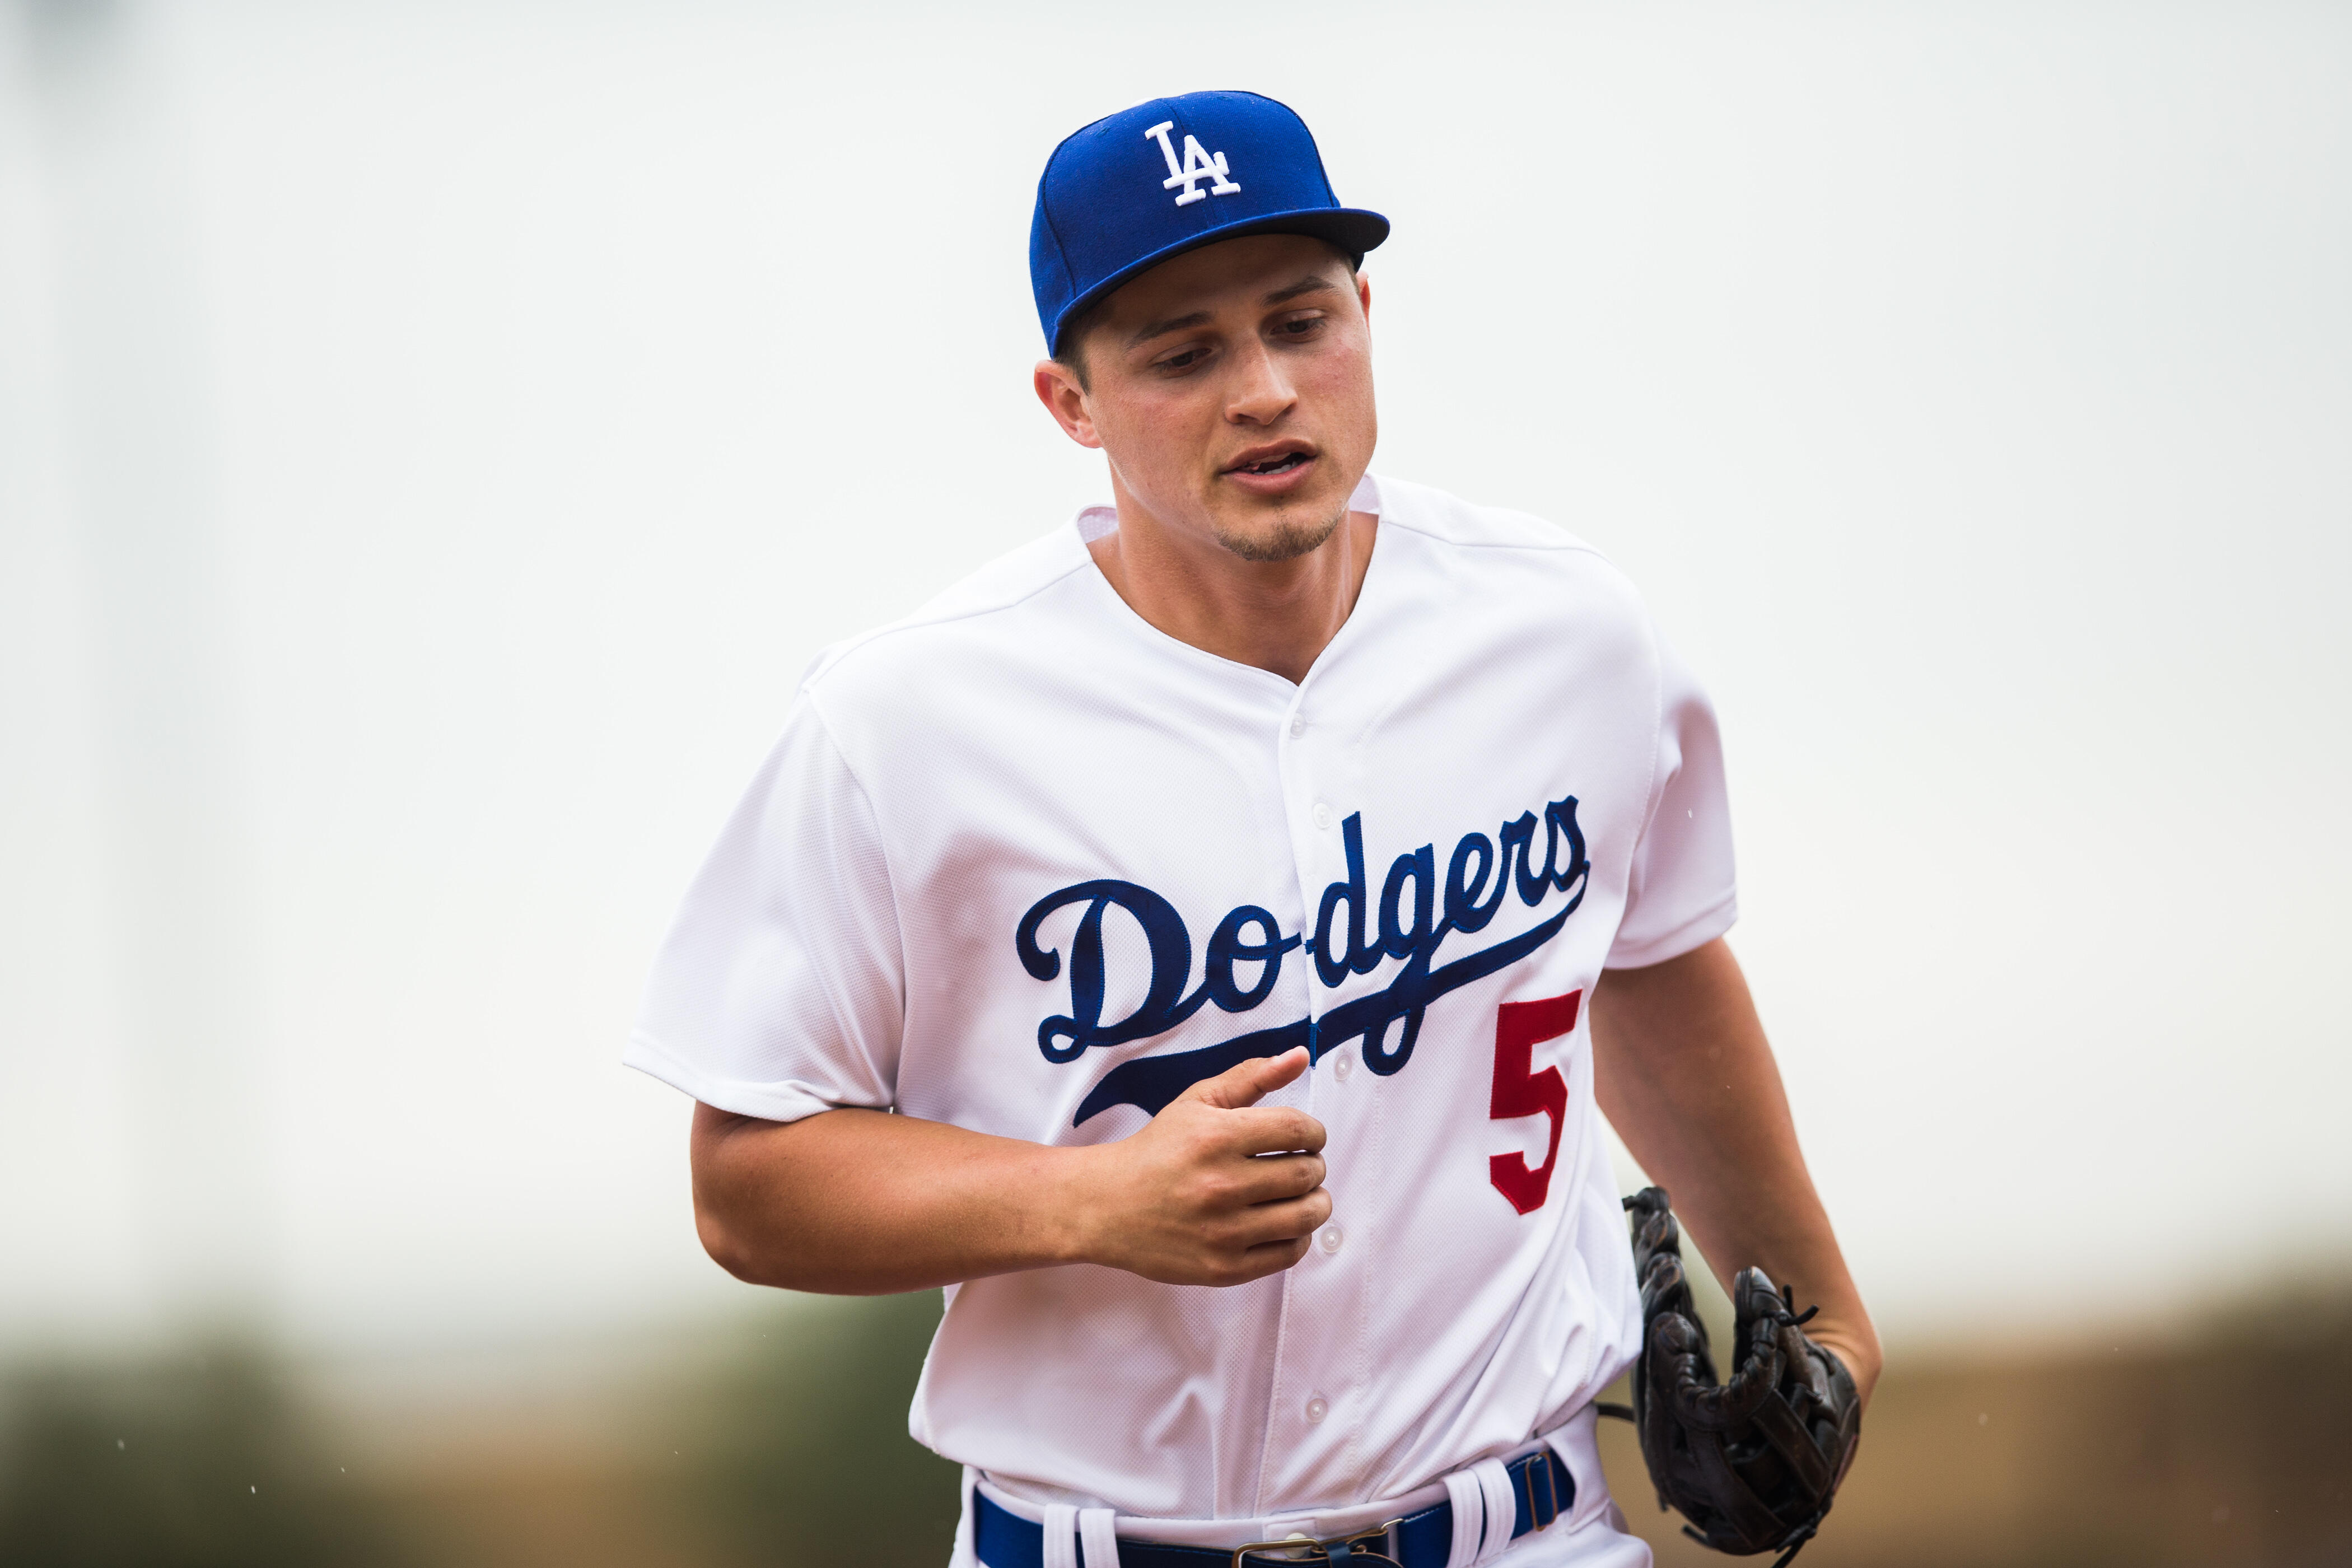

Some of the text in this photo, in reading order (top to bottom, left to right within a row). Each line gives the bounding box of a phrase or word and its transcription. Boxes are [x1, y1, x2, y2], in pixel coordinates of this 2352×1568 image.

[1145, 120, 1240, 207] LA
[1016, 795, 1590, 1076] Dodgers
[1489, 989, 1582, 1215] 5
